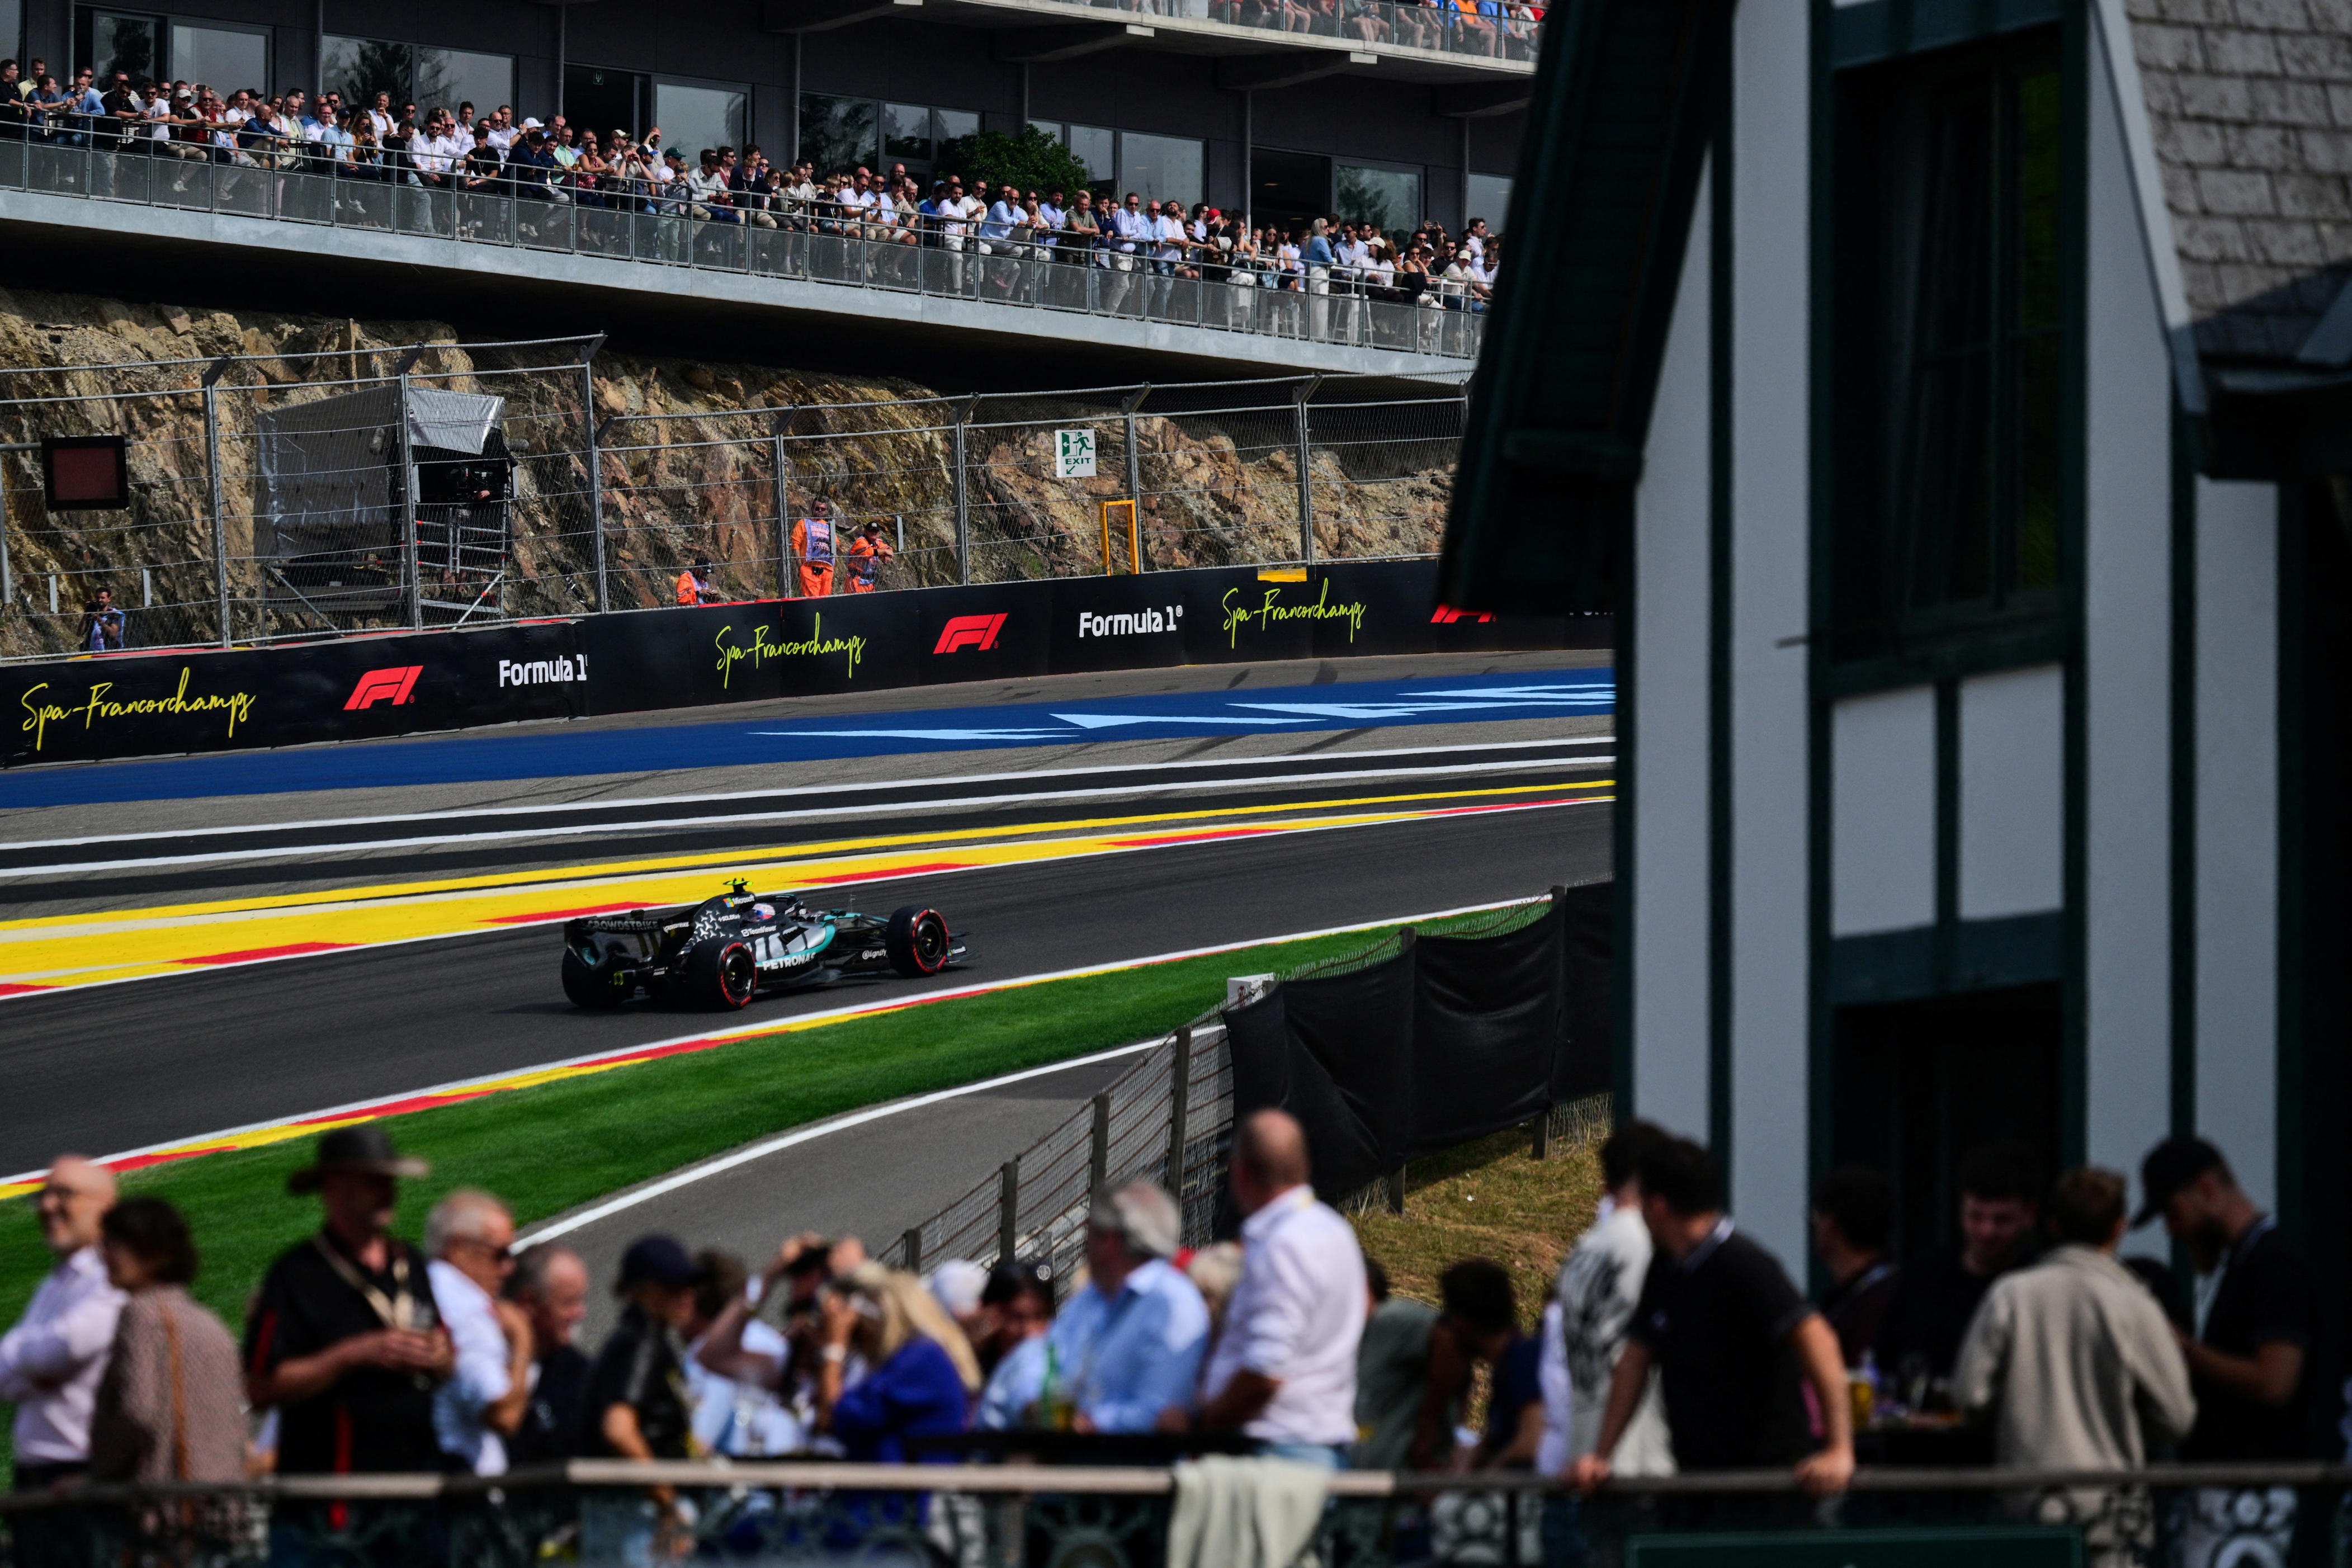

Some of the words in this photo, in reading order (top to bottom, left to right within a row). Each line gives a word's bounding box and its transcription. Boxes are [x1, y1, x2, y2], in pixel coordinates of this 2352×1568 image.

[1079, 607, 1163, 638] Formula
[1223, 577, 1366, 649] Spa-Francorchamps
[716, 612, 866, 689] Spa-Francorchamps
[933, 612, 1009, 655] F1
[343, 665, 424, 711] F1
[499, 655, 574, 688] Formula
[21, 667, 256, 751] Spa-Francorchamps
[733, 894, 755, 905] Microsoft
[588, 920, 658, 931] CROWDSTRIKE
[762, 952, 816, 971] PETRONAS
